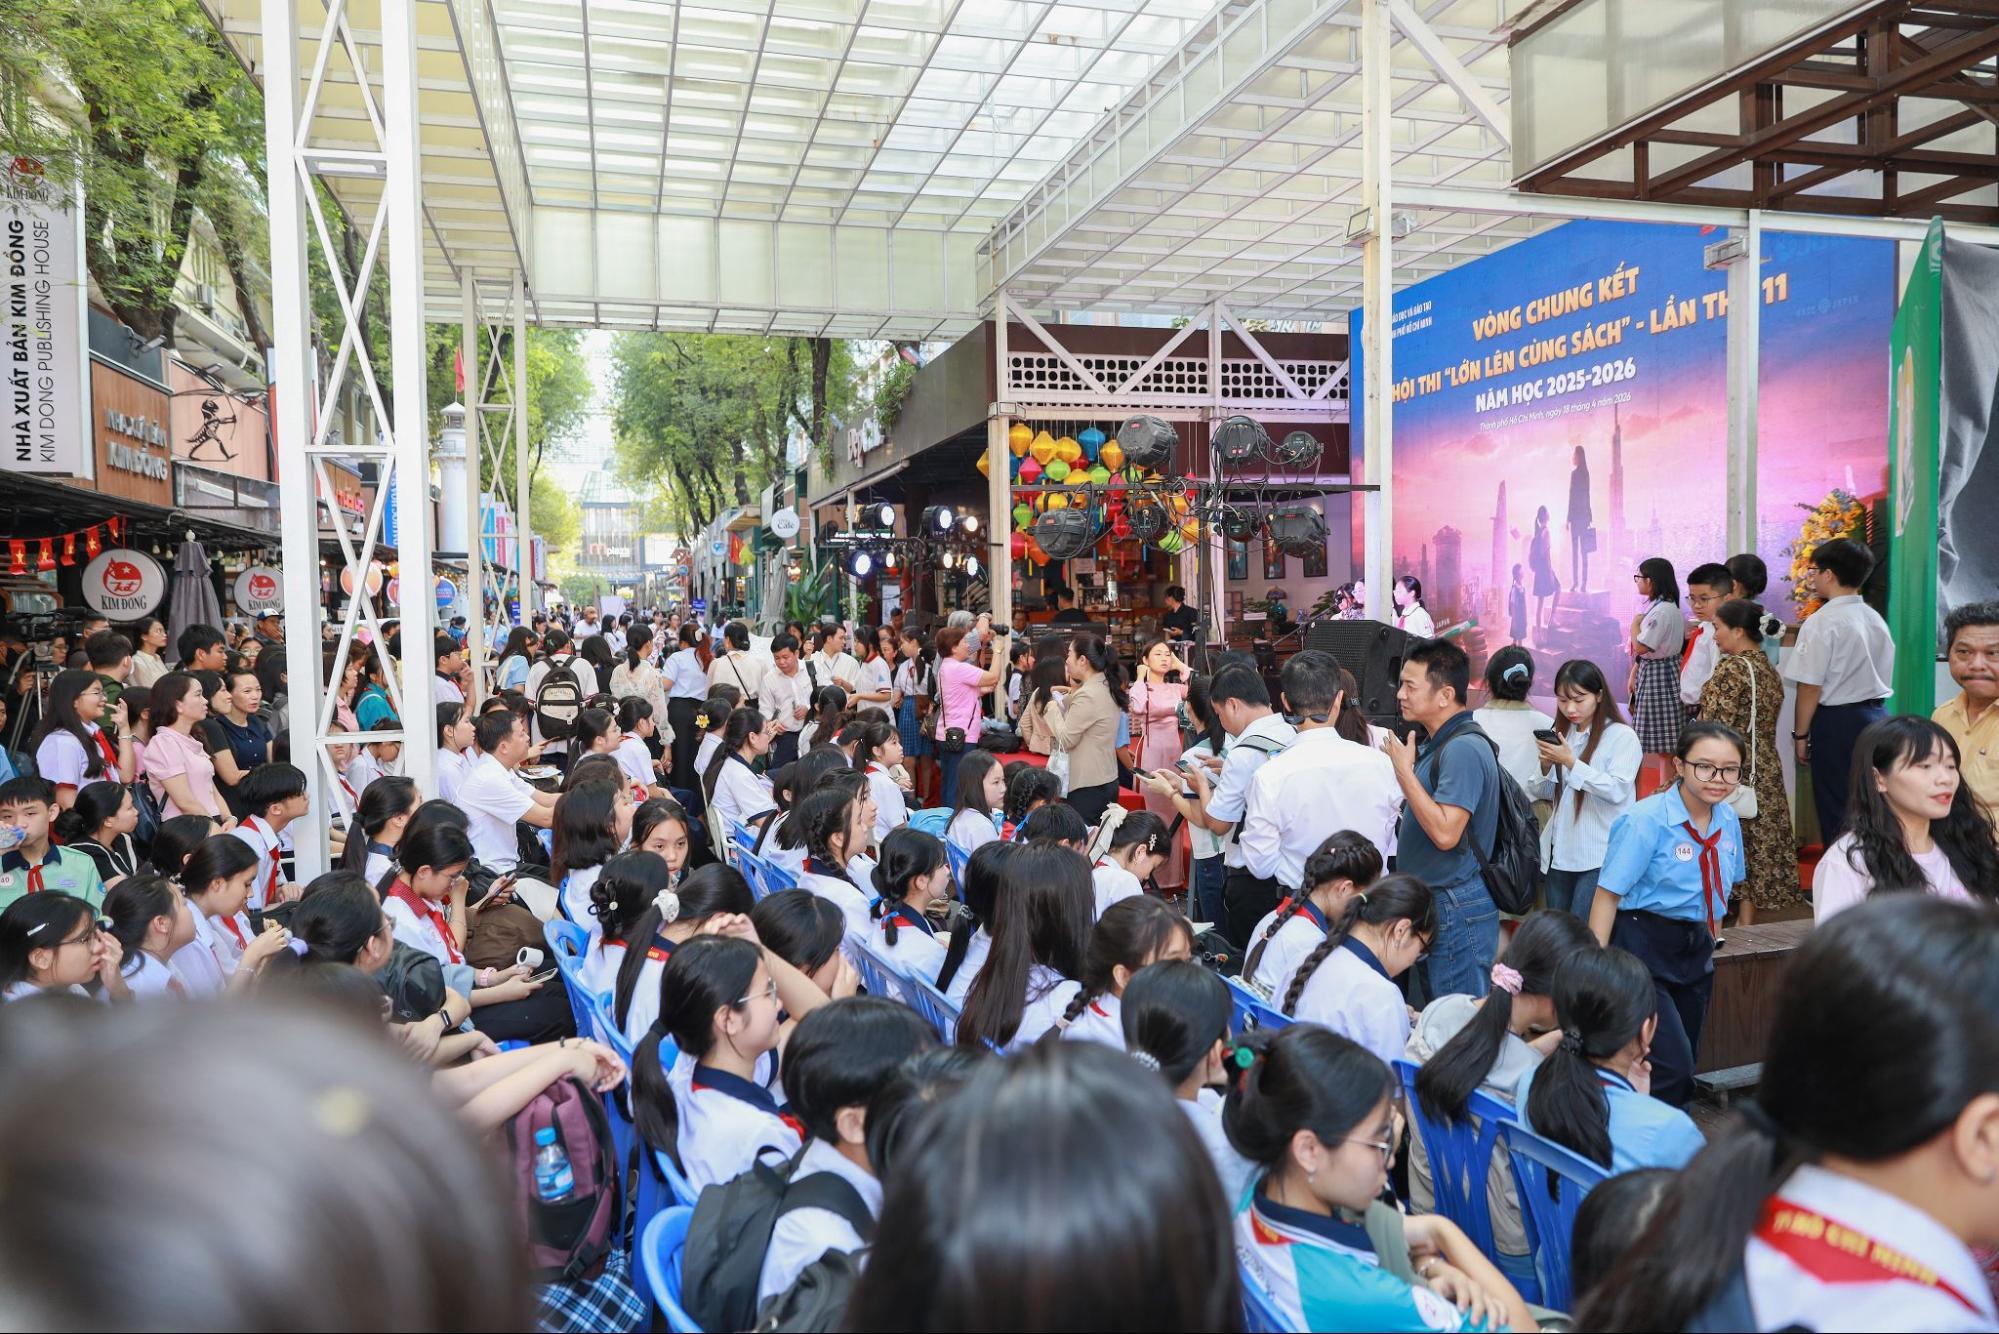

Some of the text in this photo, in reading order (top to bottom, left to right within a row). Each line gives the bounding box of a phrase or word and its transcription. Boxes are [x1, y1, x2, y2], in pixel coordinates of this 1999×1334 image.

[1472, 260, 1640, 341] VÒNG CHUNG KẾT
[3, 220, 32, 461] NHÀ XUẤT BẢN KIM ĐỒNG
[33, 220, 55, 462] KIM DONG PUBLISHING HOUSE
[1392, 376, 1416, 404] HỘI
[1418, 370, 1442, 396] THI
[1485, 349, 1515, 378] LÊN
[1519, 335, 1568, 369] CÙNG
[1650, 294, 1697, 335] LẦN
[1702, 289, 1729, 321] TH
[1761, 272, 1789, 305] 11
[1475, 356, 1637, 414] NĂM HỌC 2025-2026
[1545, 407, 1562, 420] ngày
[1571, 401, 1591, 413] tháng
[1614, 392, 1632, 404] 2026
[101, 595, 120, 610] KIM
[1678, 847, 1691, 855] 144
